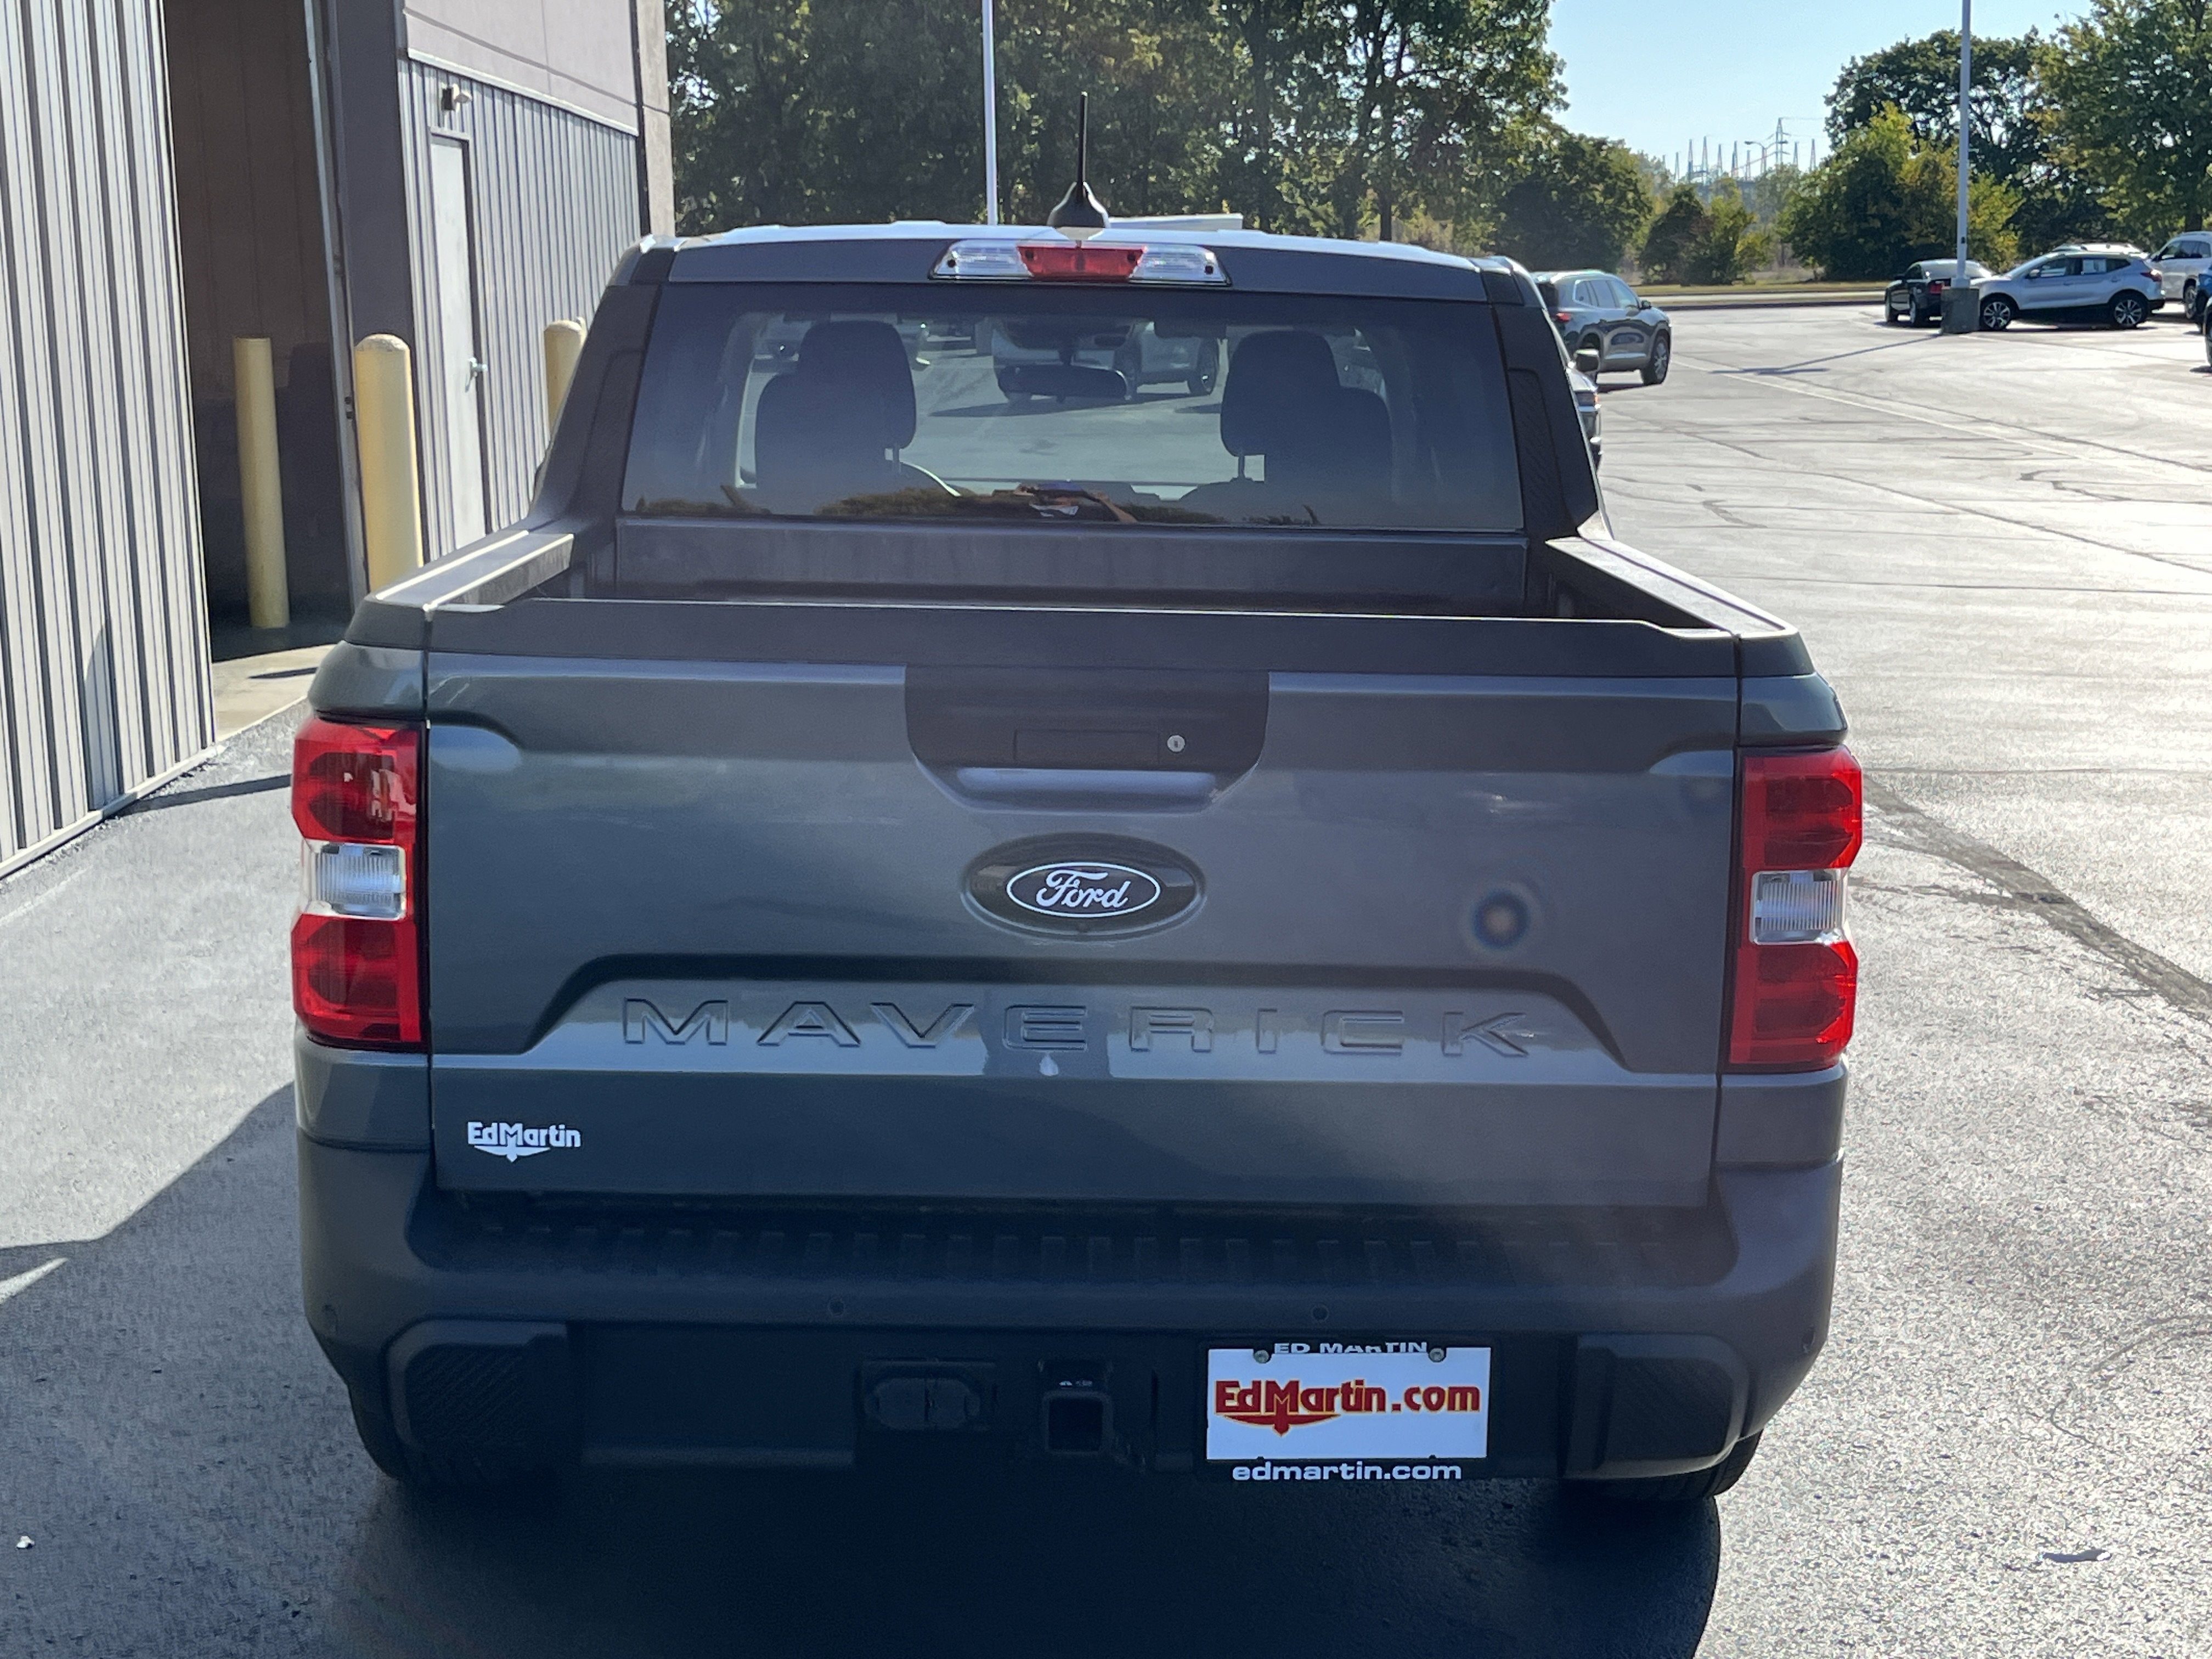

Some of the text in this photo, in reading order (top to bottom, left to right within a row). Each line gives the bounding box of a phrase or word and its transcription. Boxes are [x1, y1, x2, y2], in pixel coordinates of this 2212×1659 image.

[1036, 870, 1131, 908] Ford
[623, 997, 1530, 1057] MAVERICK
[1274, 1342, 1311, 1354] ED
[1215, 1379, 1480, 1425] EdMartin.com
[1232, 1461, 1462, 1481] edmartin.com
